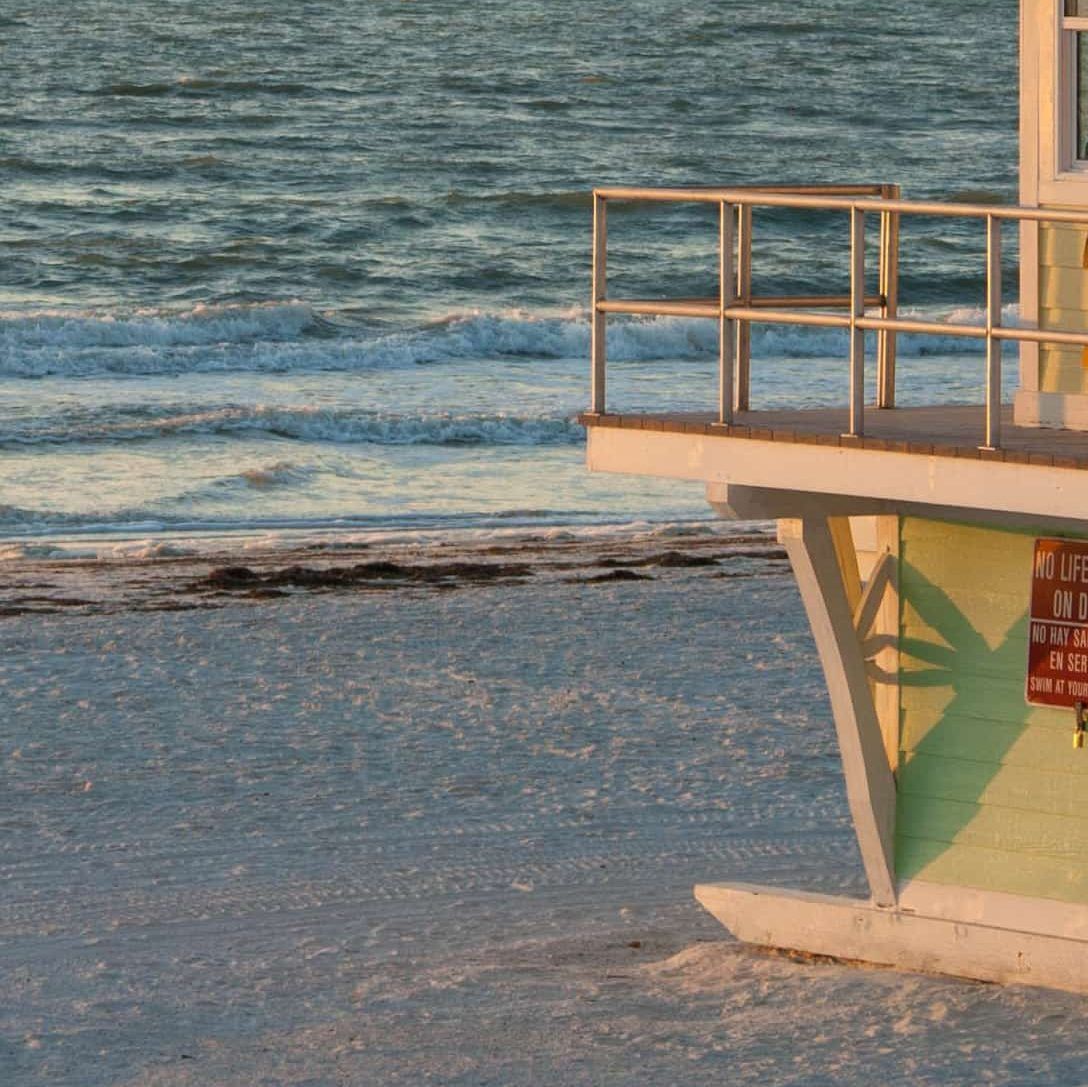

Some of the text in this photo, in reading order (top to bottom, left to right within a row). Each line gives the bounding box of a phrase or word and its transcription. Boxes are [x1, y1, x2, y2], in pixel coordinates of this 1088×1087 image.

[1035, 550, 1055, 579] NO
[1053, 590, 1073, 619] ON
[1032, 624, 1046, 644] NO
[1050, 626, 1070, 646] HAY
[1050, 651, 1063, 671] EN
[1030, 676, 1053, 693] SWIM
[1055, 679, 1065, 693] AT
[1068, 680, 1088, 697] YOUR
